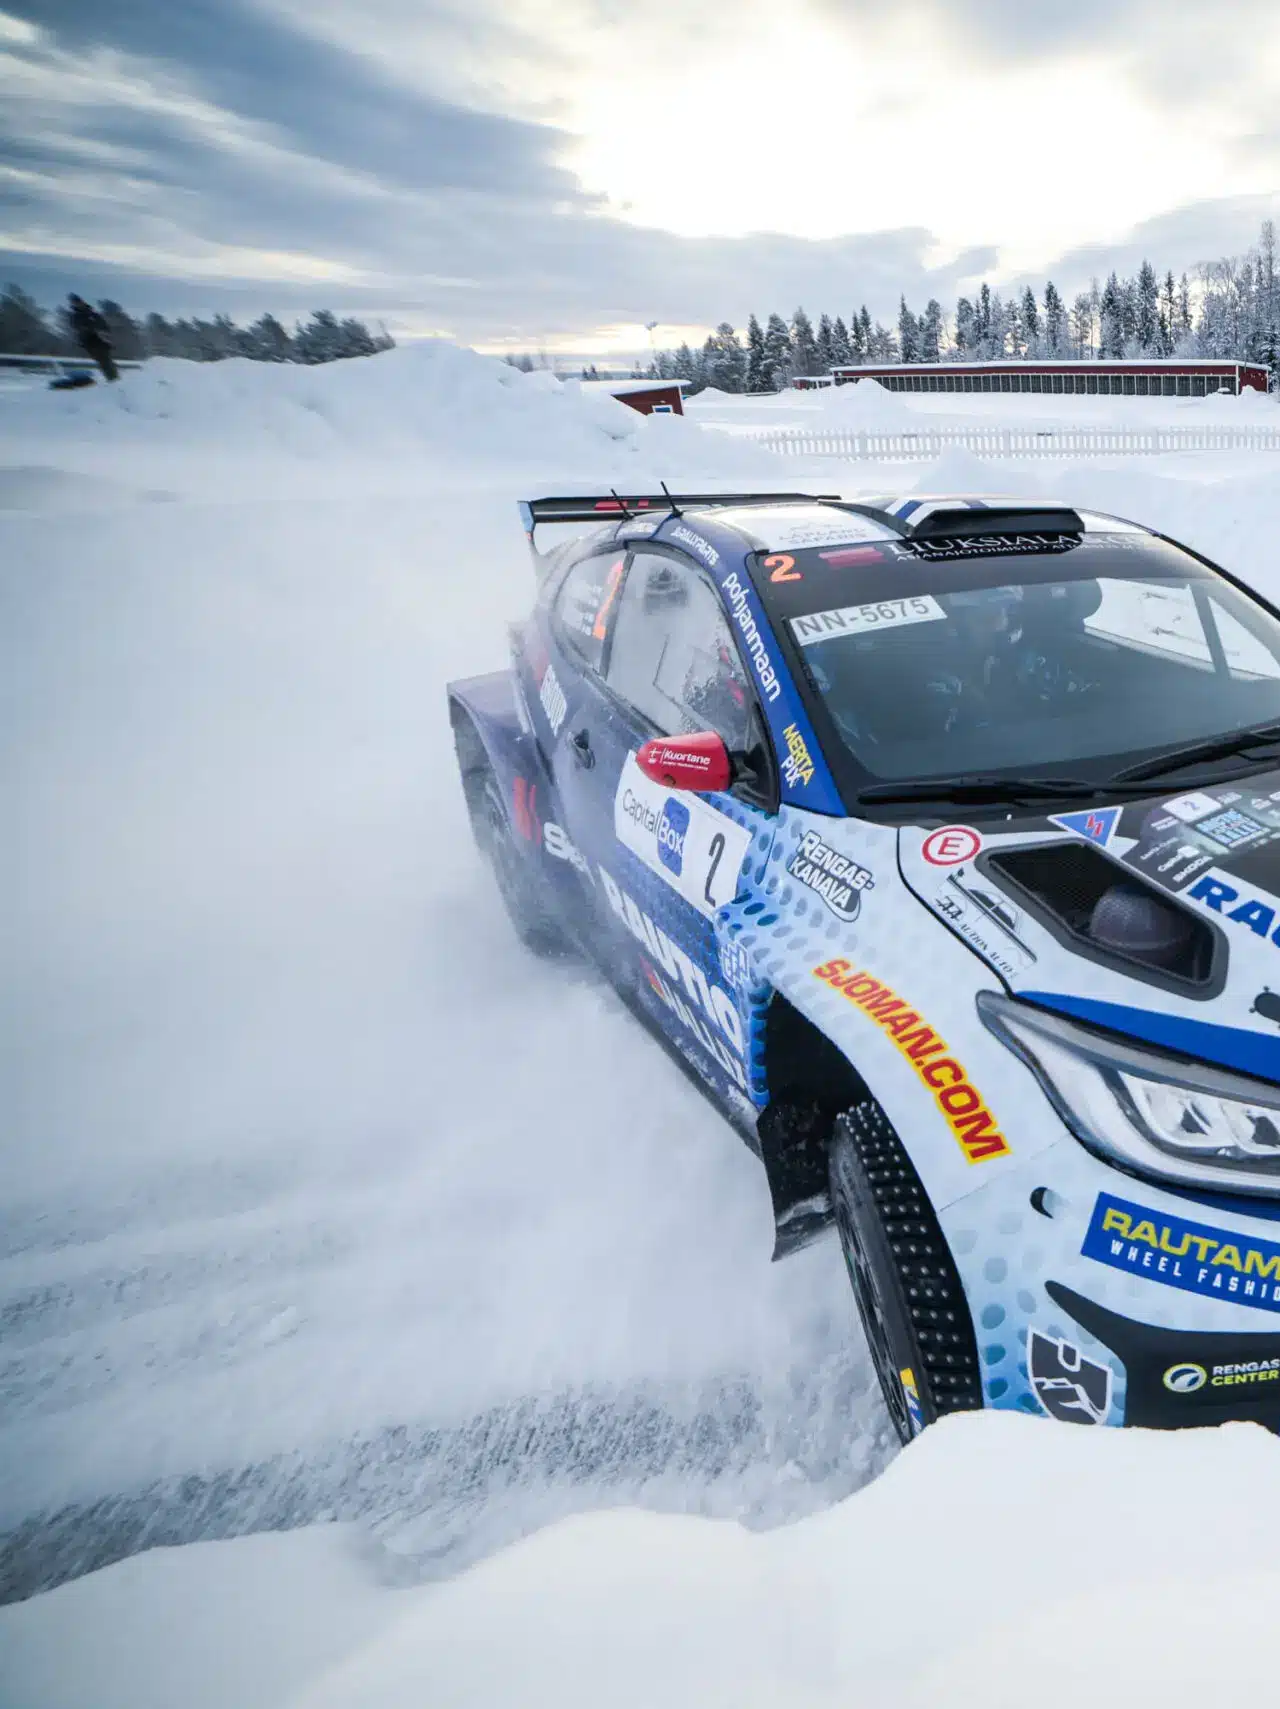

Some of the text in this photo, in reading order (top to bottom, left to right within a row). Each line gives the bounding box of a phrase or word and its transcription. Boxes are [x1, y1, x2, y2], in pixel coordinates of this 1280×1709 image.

[886, 534, 1080, 556] LIUKSIALA
[764, 555, 803, 583] 2
[796, 598, 930, 637] NN-5675
[722, 572, 781, 703] pohjanmaan
[664, 750, 711, 765] Kuortane
[781, 755, 801, 788] PIX
[782, 723, 815, 786] MERITA
[937, 835, 965, 857] E
[704, 832, 726, 908] 2
[789, 856, 852, 909] KANAVA
[813, 958, 1011, 1164] SJOMAN.COM
[1110, 1239, 1183, 1277] WHEEL
[1211, 1369, 1280, 1387] CENTER
[1212, 1358, 1280, 1376] RENGAS
